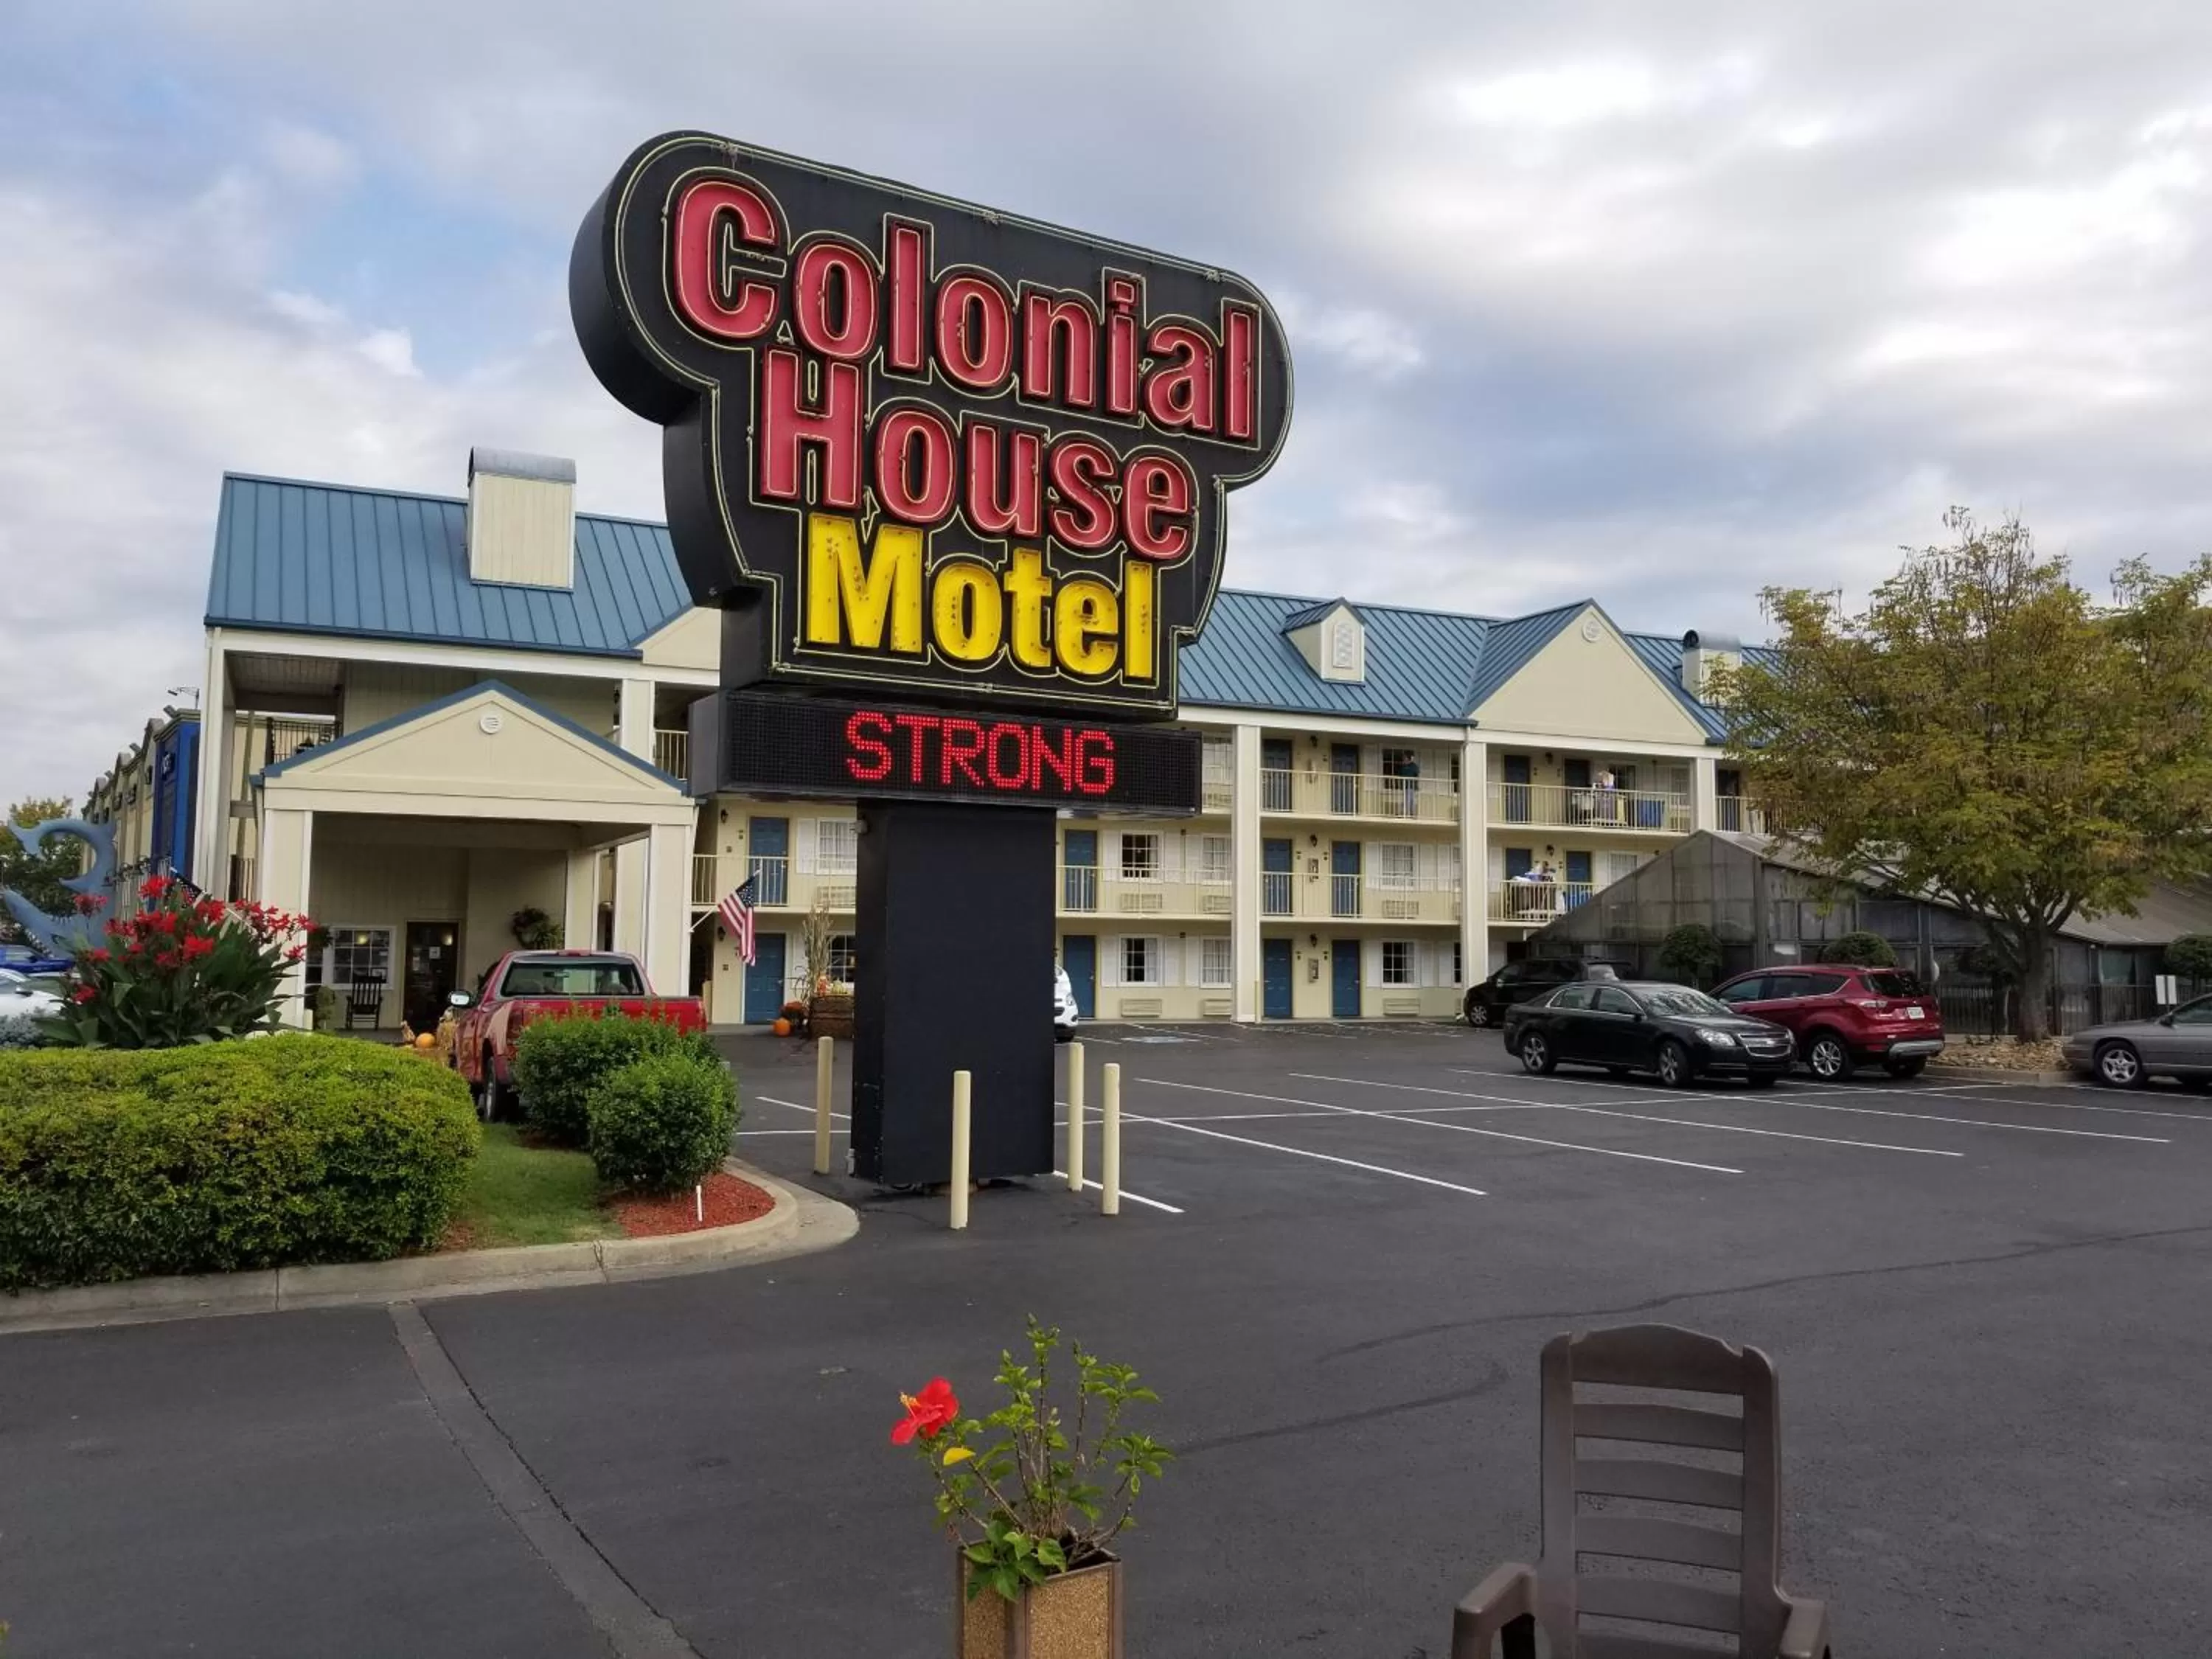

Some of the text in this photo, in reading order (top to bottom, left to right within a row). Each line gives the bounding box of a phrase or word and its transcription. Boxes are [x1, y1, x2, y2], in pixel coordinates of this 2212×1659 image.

[674, 177, 1257, 444] Colonial
[759, 344, 1191, 561] House
[806, 512, 1156, 681] Motel
[846, 710, 1115, 794] STRONG
